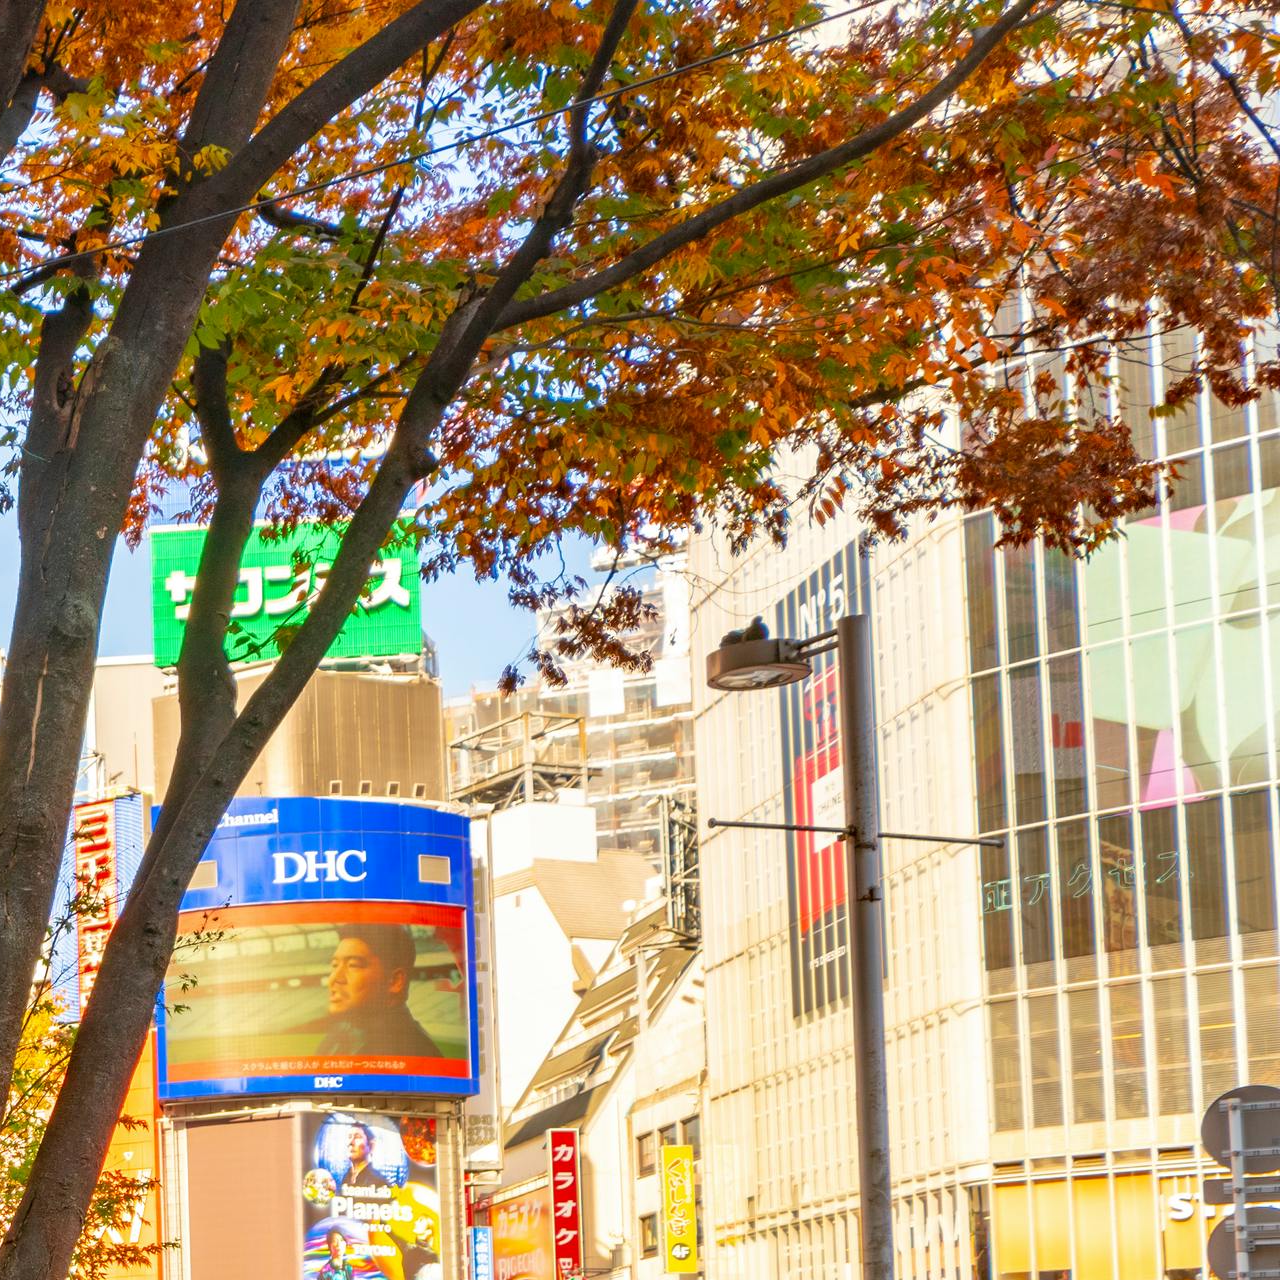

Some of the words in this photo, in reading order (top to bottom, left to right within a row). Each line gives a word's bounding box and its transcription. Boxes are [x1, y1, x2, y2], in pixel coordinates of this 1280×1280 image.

[272, 849, 368, 885] DHC
[313, 1076, 344, 1088] DHC
[342, 1183, 392, 1198] teamLab
[553, 1143, 578, 1246] カラオケ
[331, 1196, 414, 1222] Planets
